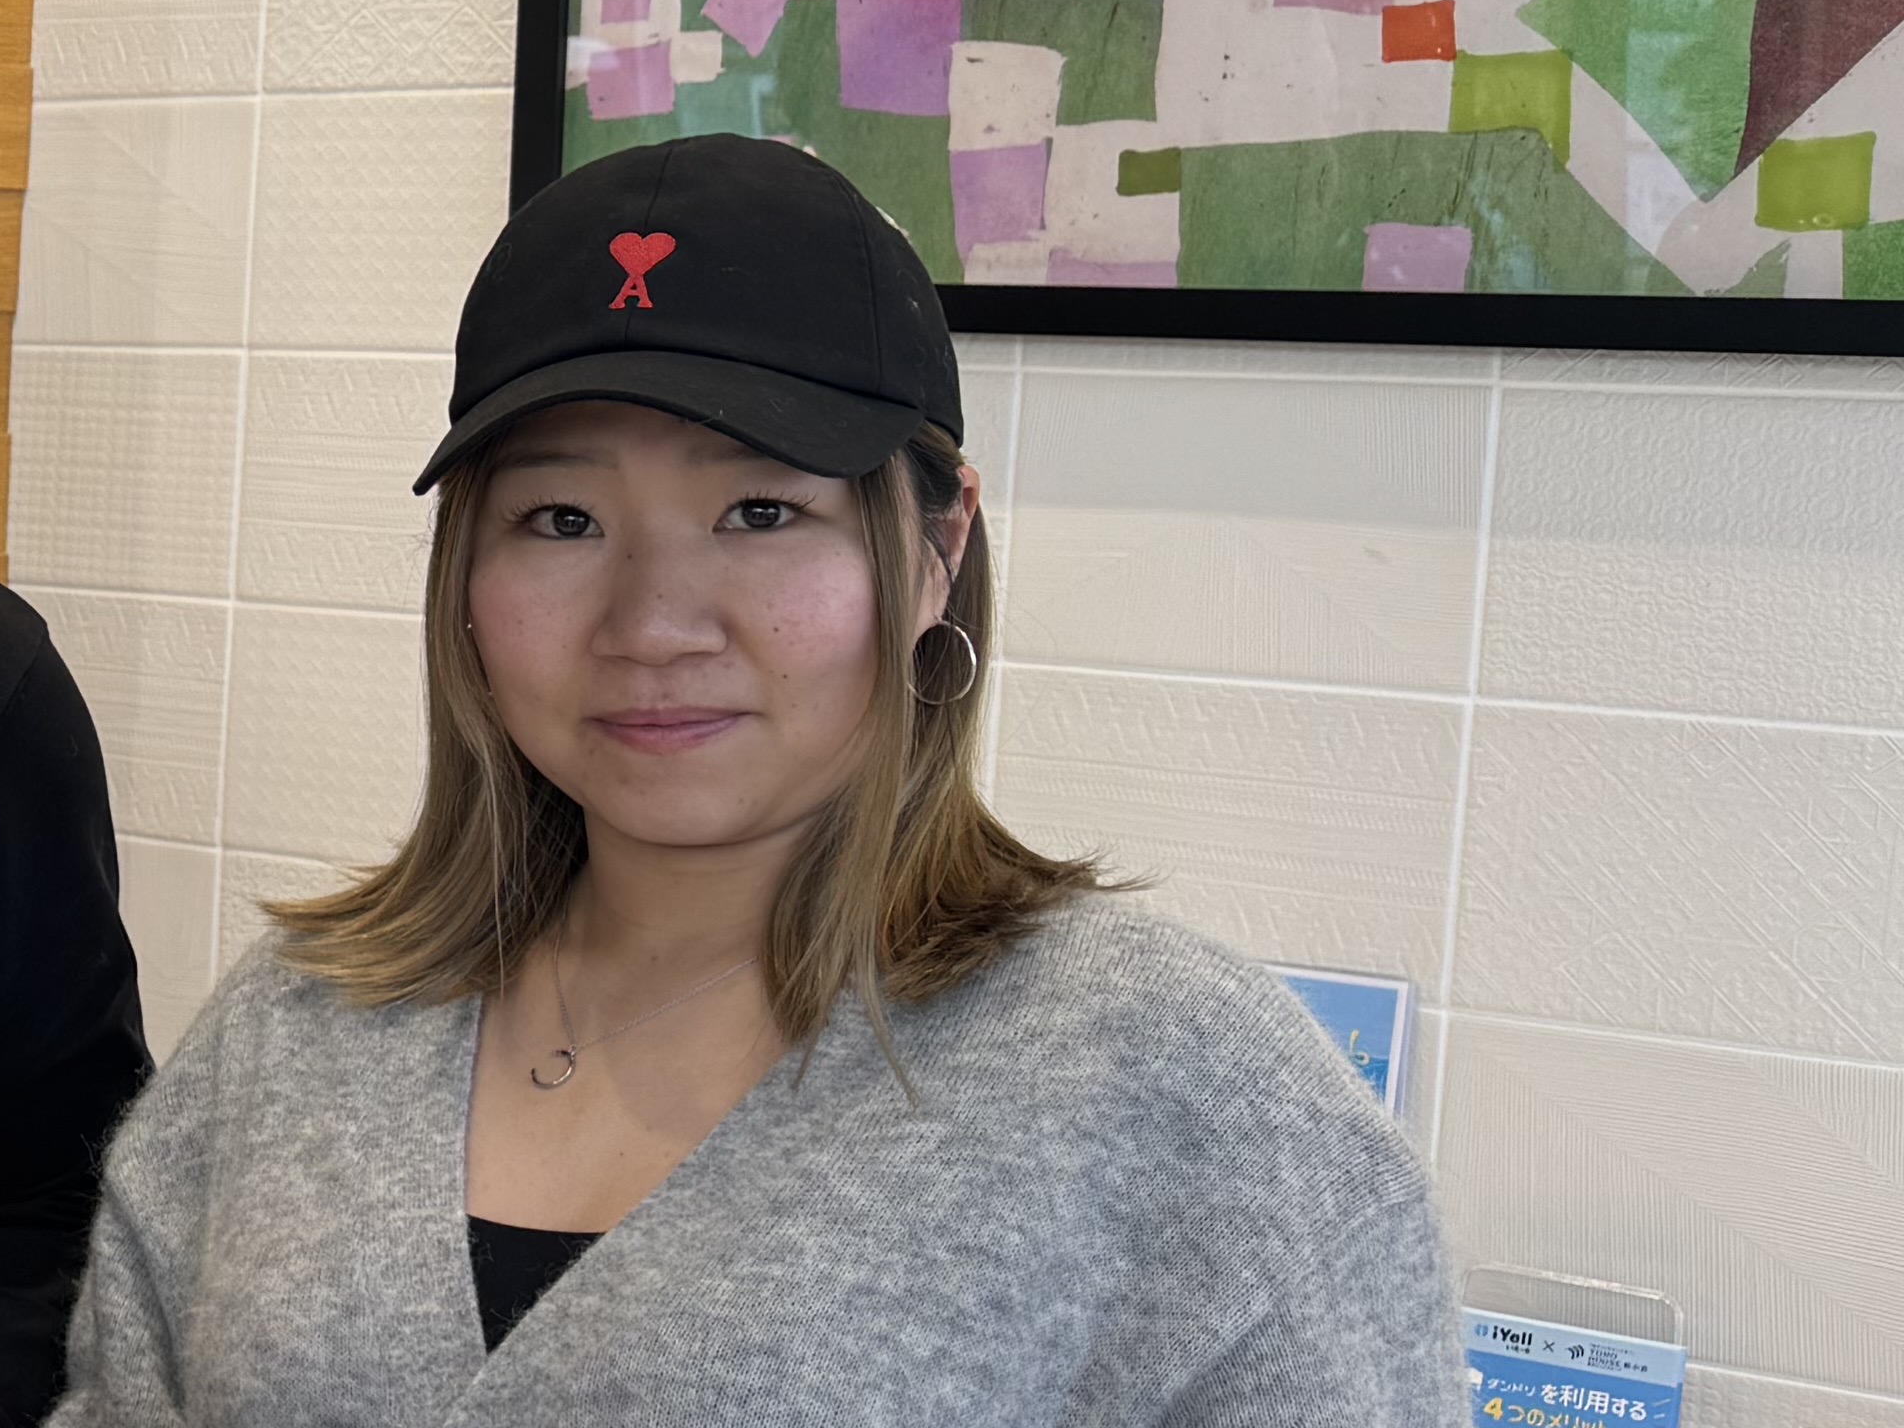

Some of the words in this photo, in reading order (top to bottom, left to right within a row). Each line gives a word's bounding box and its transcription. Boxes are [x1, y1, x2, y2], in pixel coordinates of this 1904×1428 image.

[1541, 1383, 1648, 1422] を利用する
